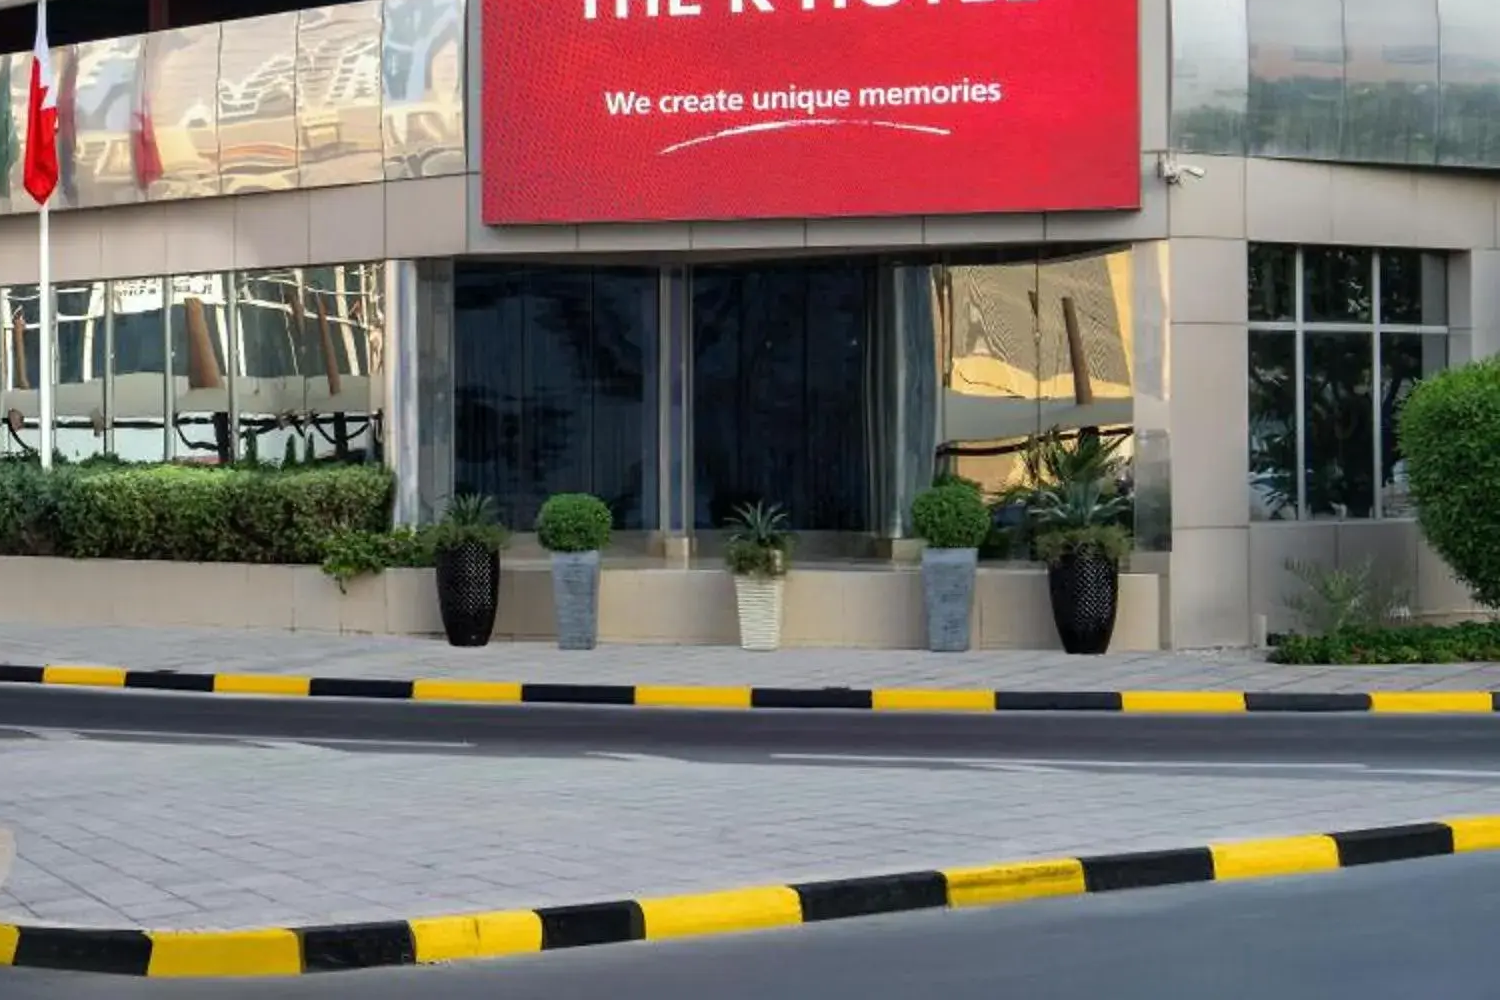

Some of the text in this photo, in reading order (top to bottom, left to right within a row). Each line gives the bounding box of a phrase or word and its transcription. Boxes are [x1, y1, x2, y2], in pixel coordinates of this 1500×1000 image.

[605, 78, 1002, 116] We create unique memories
